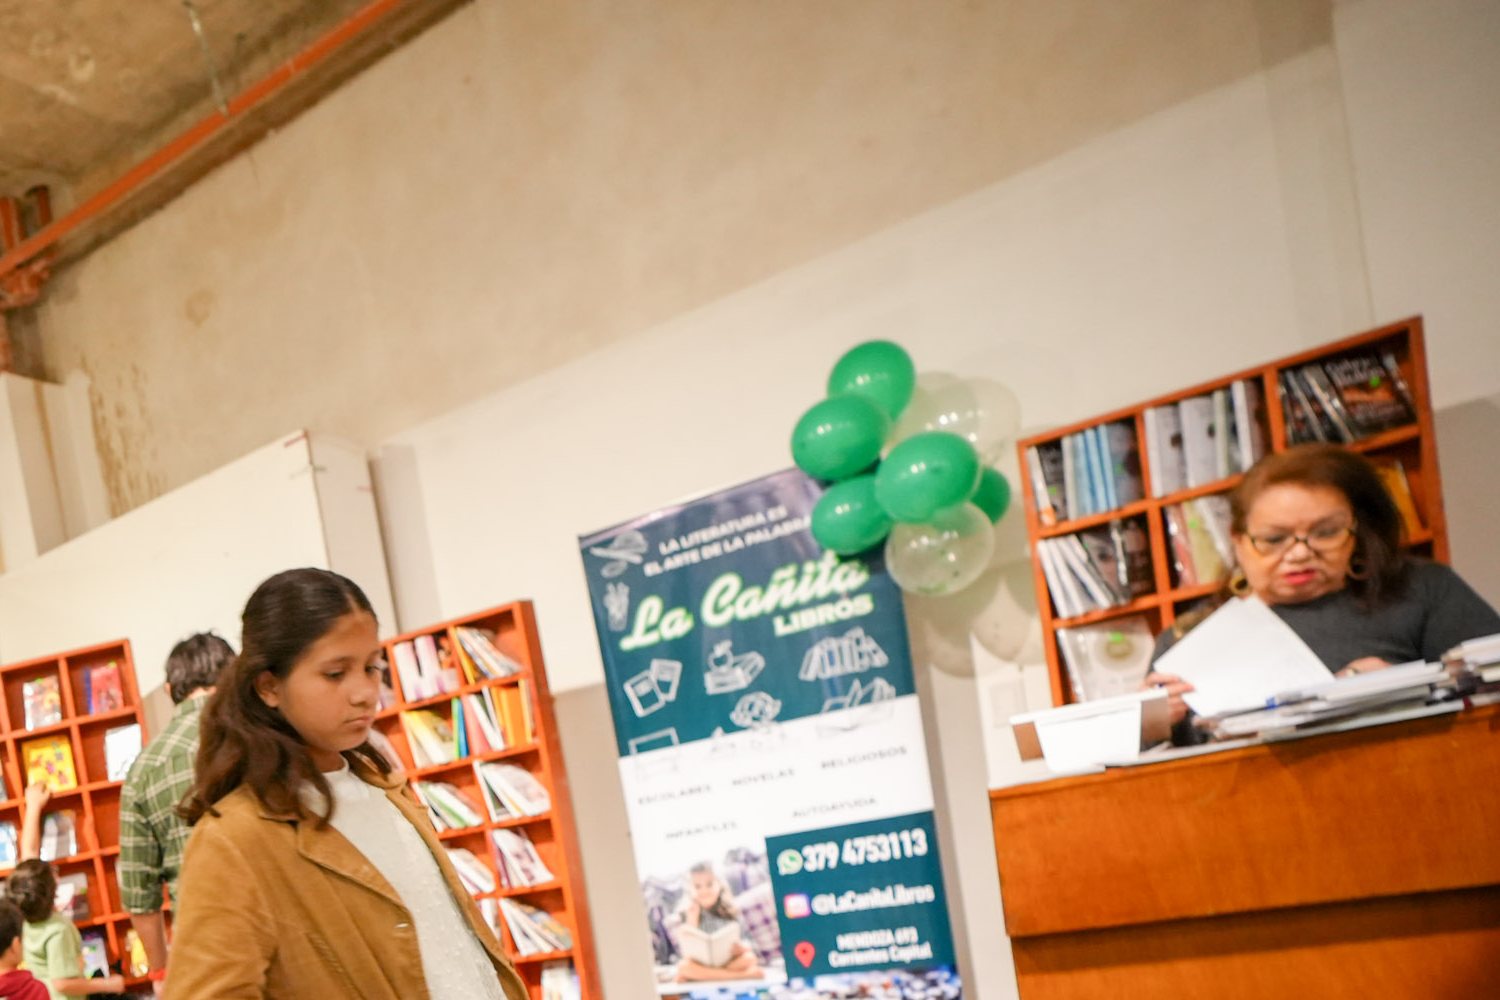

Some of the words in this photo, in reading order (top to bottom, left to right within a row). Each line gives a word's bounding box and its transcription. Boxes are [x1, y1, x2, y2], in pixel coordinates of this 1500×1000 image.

[659, 538, 680, 555] LA
[680, 512, 767, 549] LITERATURA
[767, 504, 788, 522] ES
[643, 561, 663, 577] EL
[663, 548, 700, 571] ARTE
[700, 541, 723, 560] DE
[723, 536, 745, 553] LA
[618, 594, 695, 652] La
[700, 548, 871, 628] Cañita
[773, 593, 875, 638] LIBROS
[731, 767, 796, 787] NOVELAS
[820, 744, 908, 770] RELIGIOSOS
[802, 841, 839, 872] 379
[842, 827, 928, 866] 4753113
[836, 928, 895, 951] MENDOZA
